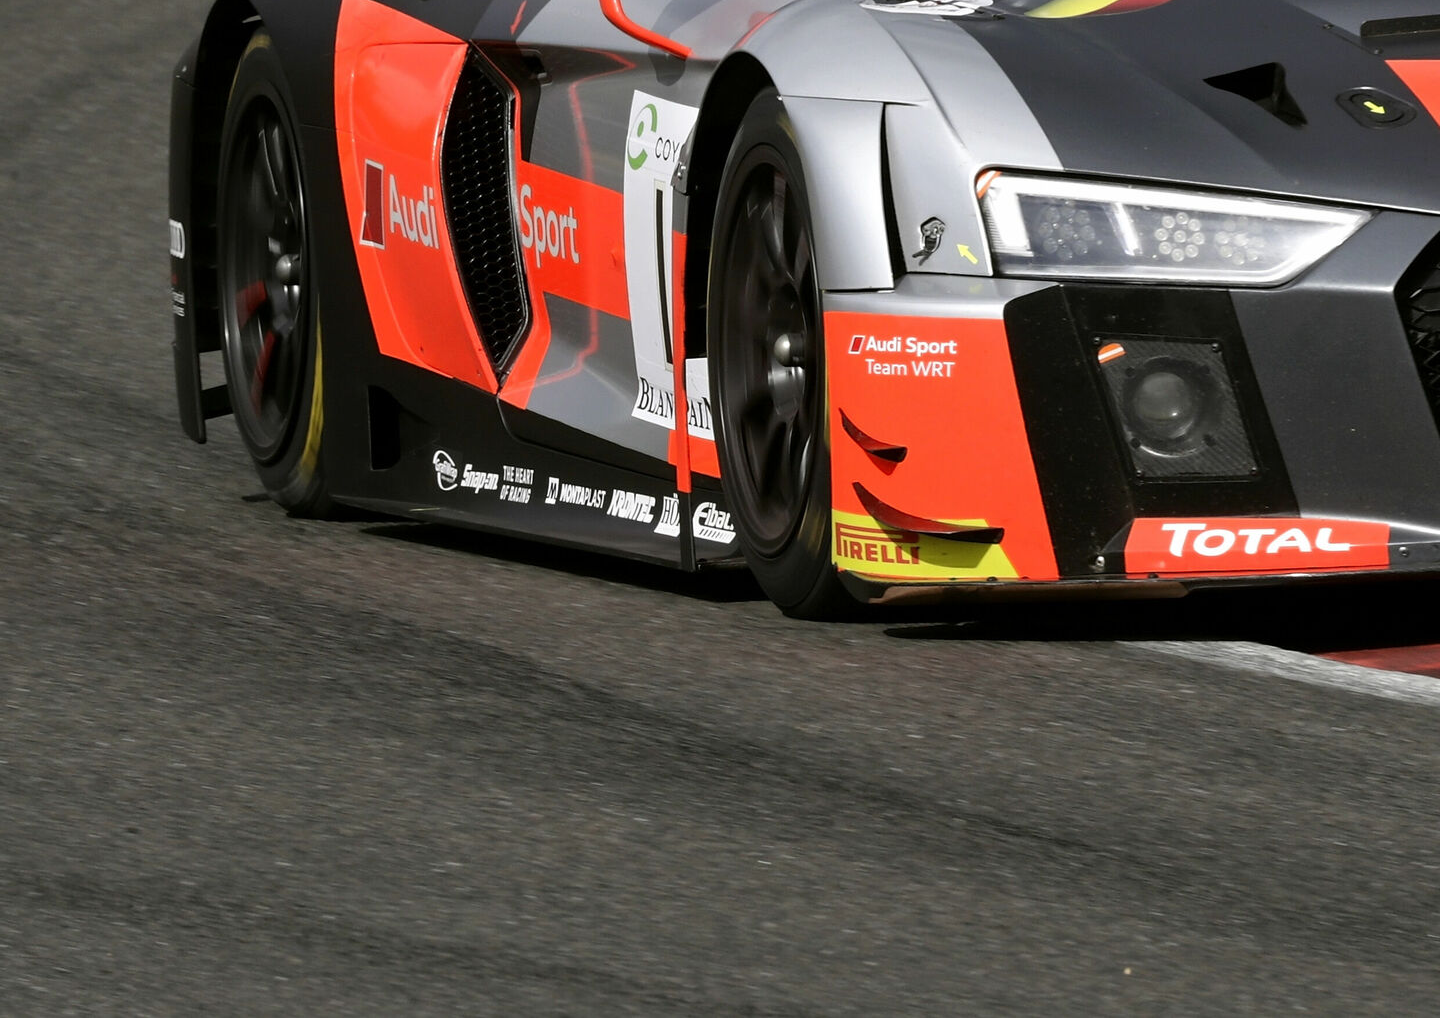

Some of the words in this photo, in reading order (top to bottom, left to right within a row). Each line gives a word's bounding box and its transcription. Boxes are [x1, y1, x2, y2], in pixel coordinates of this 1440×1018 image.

[655, 137, 680, 162] COY
[389, 174, 439, 249] Audi
[520, 184, 580, 268] Sport
[866, 336, 902, 352] Audi
[905, 337, 957, 357] Sport
[865, 358, 907, 376] Team
[911, 361, 955, 377] WRT
[637, 376, 712, 430] BLANAIN
[503, 465, 515, 482] THE
[515, 467, 535, 485] HEART
[500, 485, 509, 500] OF
[508, 486, 532, 503] RACING
[559, 483, 606, 508] MONTAPLAST
[835, 522, 920, 565] PIRELLI
[1161, 523, 1351, 557] TOTAL
